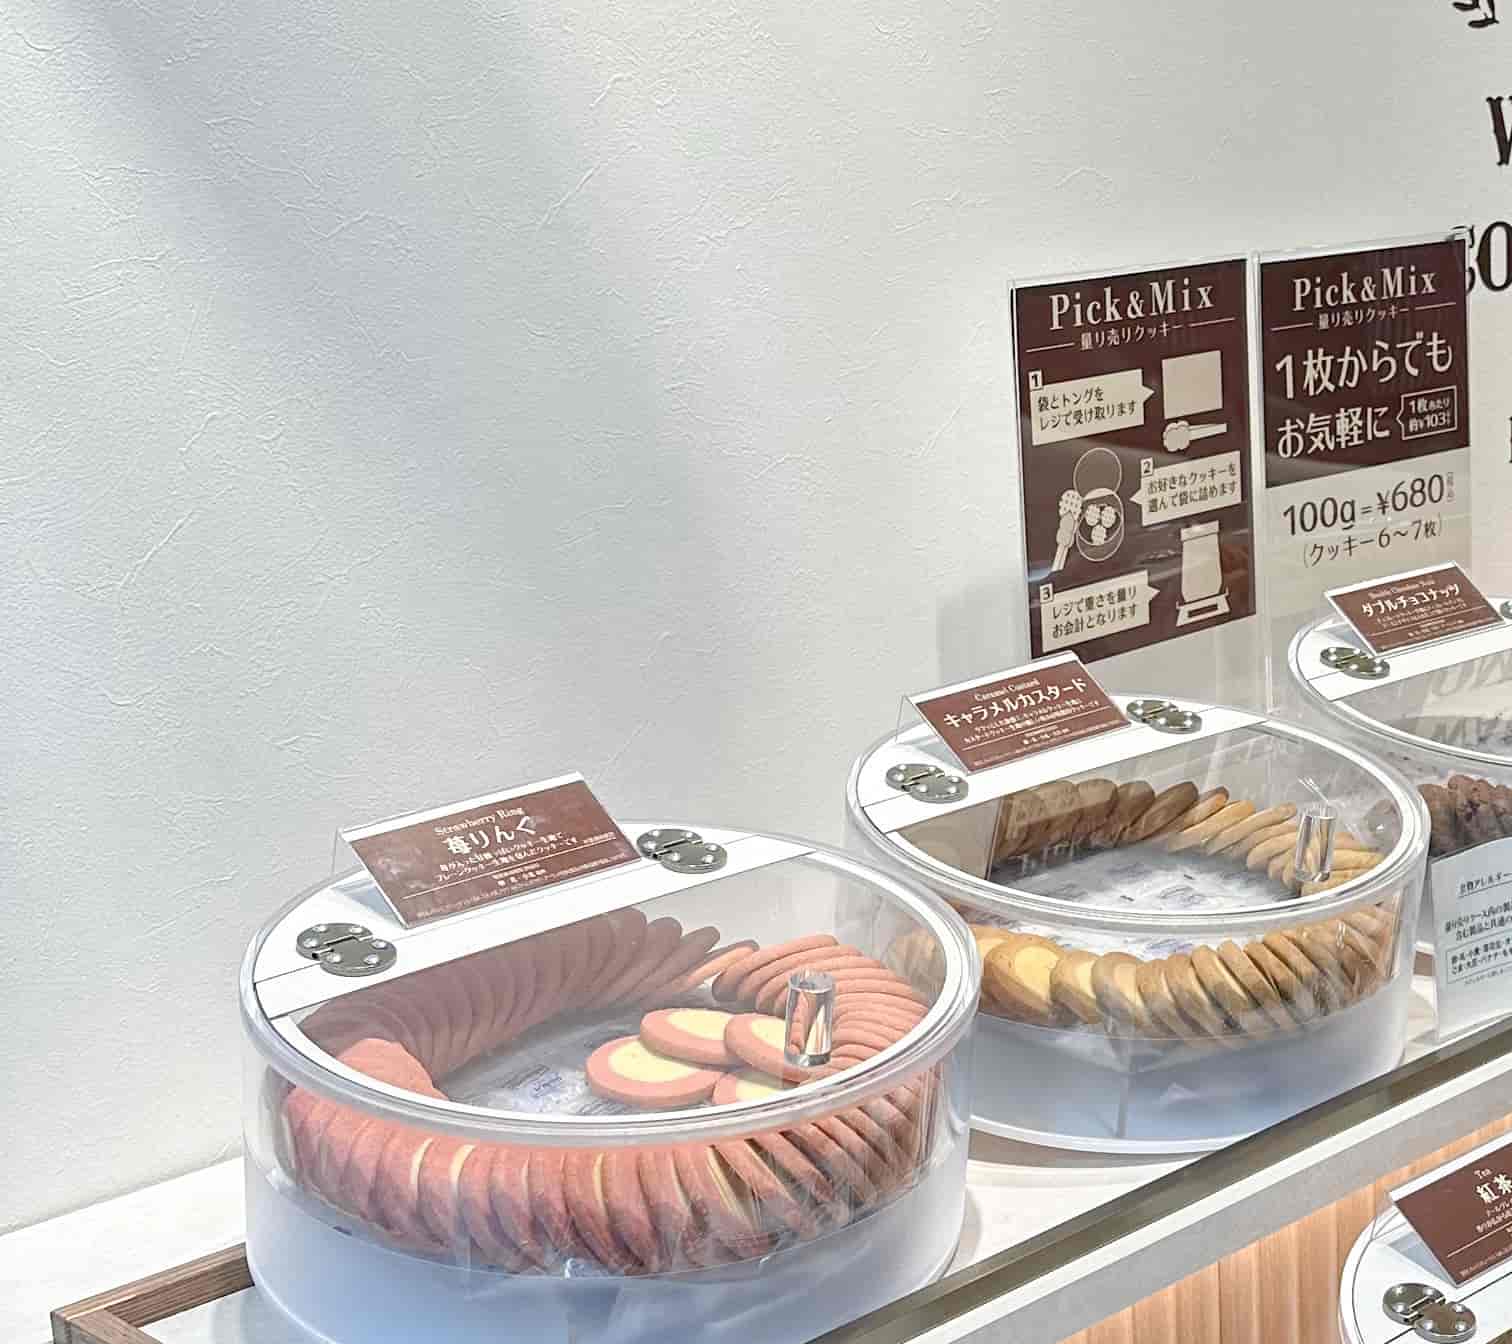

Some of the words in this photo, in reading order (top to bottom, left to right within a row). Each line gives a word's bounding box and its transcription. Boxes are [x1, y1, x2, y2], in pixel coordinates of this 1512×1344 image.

[1293, 265, 1437, 311] Pick&Mix
[1050, 278, 1213, 332] Pick&Mix
[1319, 306, 1409, 330] 量り売りクッキー
[1080, 323, 1184, 351] 量り売りクッキー
[1031, 374, 1039, 387] 1
[1275, 331, 1453, 400] 1枚からでも
[1038, 387, 1104, 412] 袋とトングを
[1040, 401, 1137, 430] レジで受け取ります
[1278, 406, 1391, 457] お気軽に
[1144, 460, 1152, 473] 2
[1147, 463, 1236, 495] お好きなクッキーを
[1148, 481, 1239, 513] 選んで袋に詰めます
[1042, 586, 1051, 599] 3
[1361, 584, 1461, 617] ダブルチョコナッツ
[1052, 604, 1137, 638] お会計となります
[944, 677, 1088, 728] キャラメルカスタード
[434, 811, 494, 837] Strawberry
[497, 807, 524, 823] Ring
[443, 815, 537, 854] 苺りんぐ
